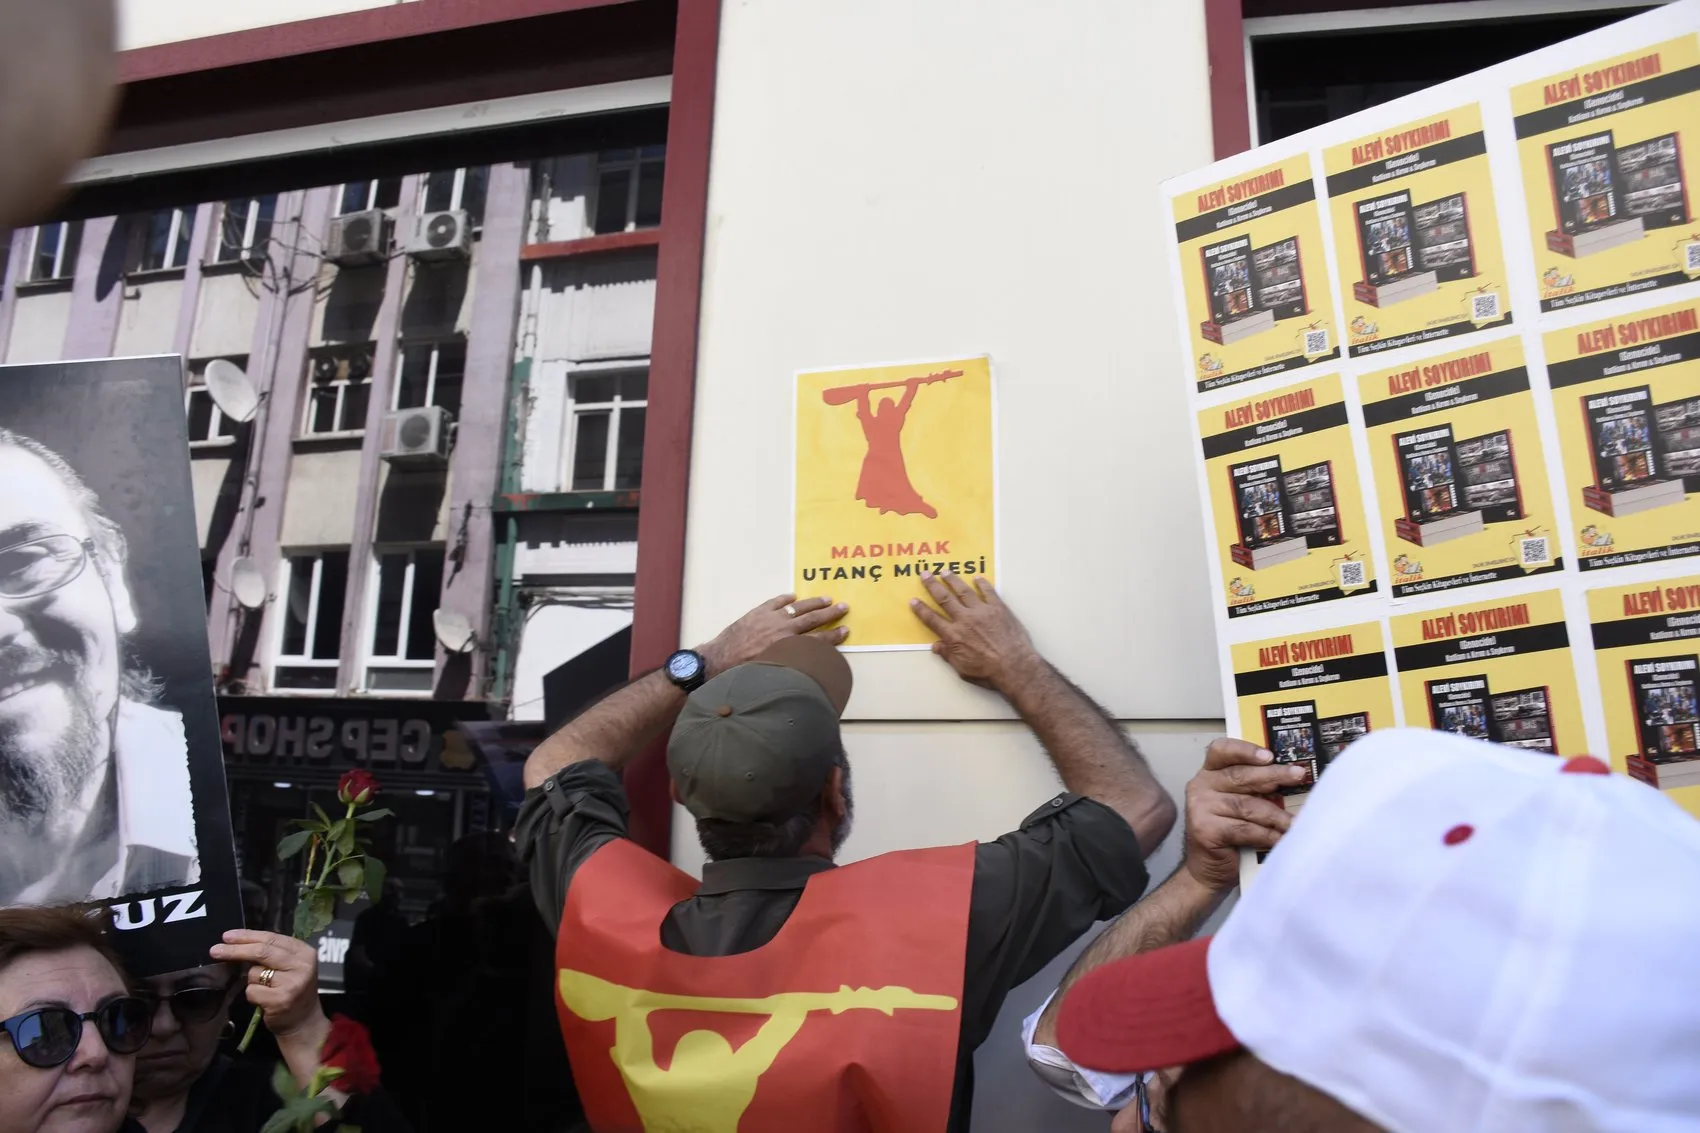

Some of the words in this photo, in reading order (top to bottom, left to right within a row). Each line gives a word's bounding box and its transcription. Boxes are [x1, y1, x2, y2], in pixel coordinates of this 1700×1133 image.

[1545, 73, 1581, 106] ALEVİ
[1582, 53, 1660, 94] SOYKIRIMI
[1352, 136, 1383, 166] ALEVİ
[1384, 119, 1450, 156] SOYKIRIMI
[1199, 185, 1225, 213] ALEVİ
[1226, 168, 1284, 204] SOYKIRIMI
[1578, 323, 1616, 355] ALEVİ
[1617, 308, 1697, 346] SOYKIRIMI
[1389, 366, 1422, 396] ALEVİ
[1422, 352, 1492, 387] SOYKIRIMI
[1225, 401, 1254, 429] ALEVİ
[1254, 388, 1314, 421] SOYKIRIMI
[831, 540, 951, 560] MADIMAK
[803, 564, 883, 582] UTANÇ
[894, 556, 986, 577] MÜZESİ
[1624, 586, 1663, 616] ALEVİ
[1423, 612, 1456, 640] ALEVİ
[1457, 603, 1529, 635] SOYKIRIMI
[1260, 641, 1289, 667] ALEVİ
[1290, 634, 1353, 662] SOYKIRIMI
[1458, 636, 1497, 650] (Genocide)
[1291, 664, 1324, 677] (Genocide)
